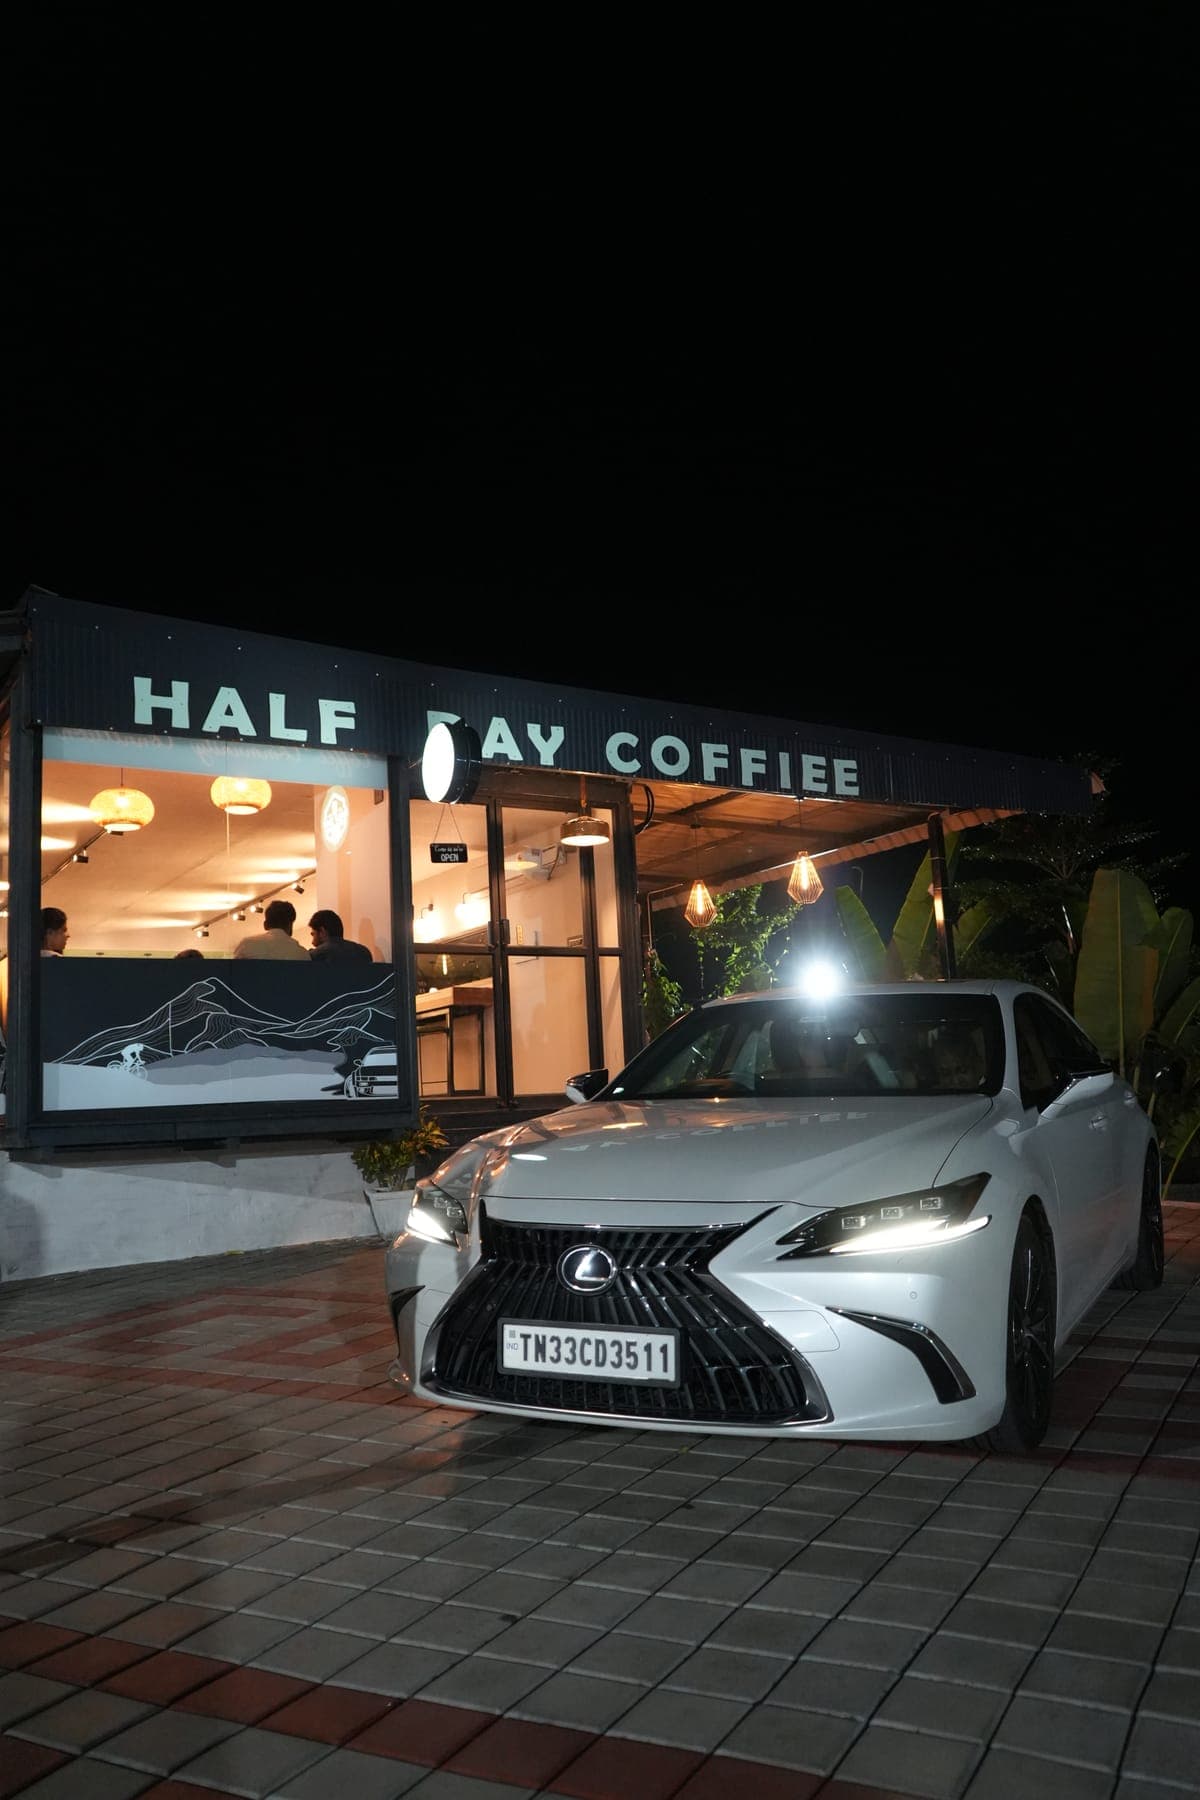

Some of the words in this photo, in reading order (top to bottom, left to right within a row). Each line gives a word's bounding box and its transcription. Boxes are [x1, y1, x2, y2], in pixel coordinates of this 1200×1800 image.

[134, 676, 356, 745] HALF
[605, 732, 860, 796] COFFIEE
[440, 853, 459, 862] OPEN
[520, 1333, 668, 1373] TN33CD3511
